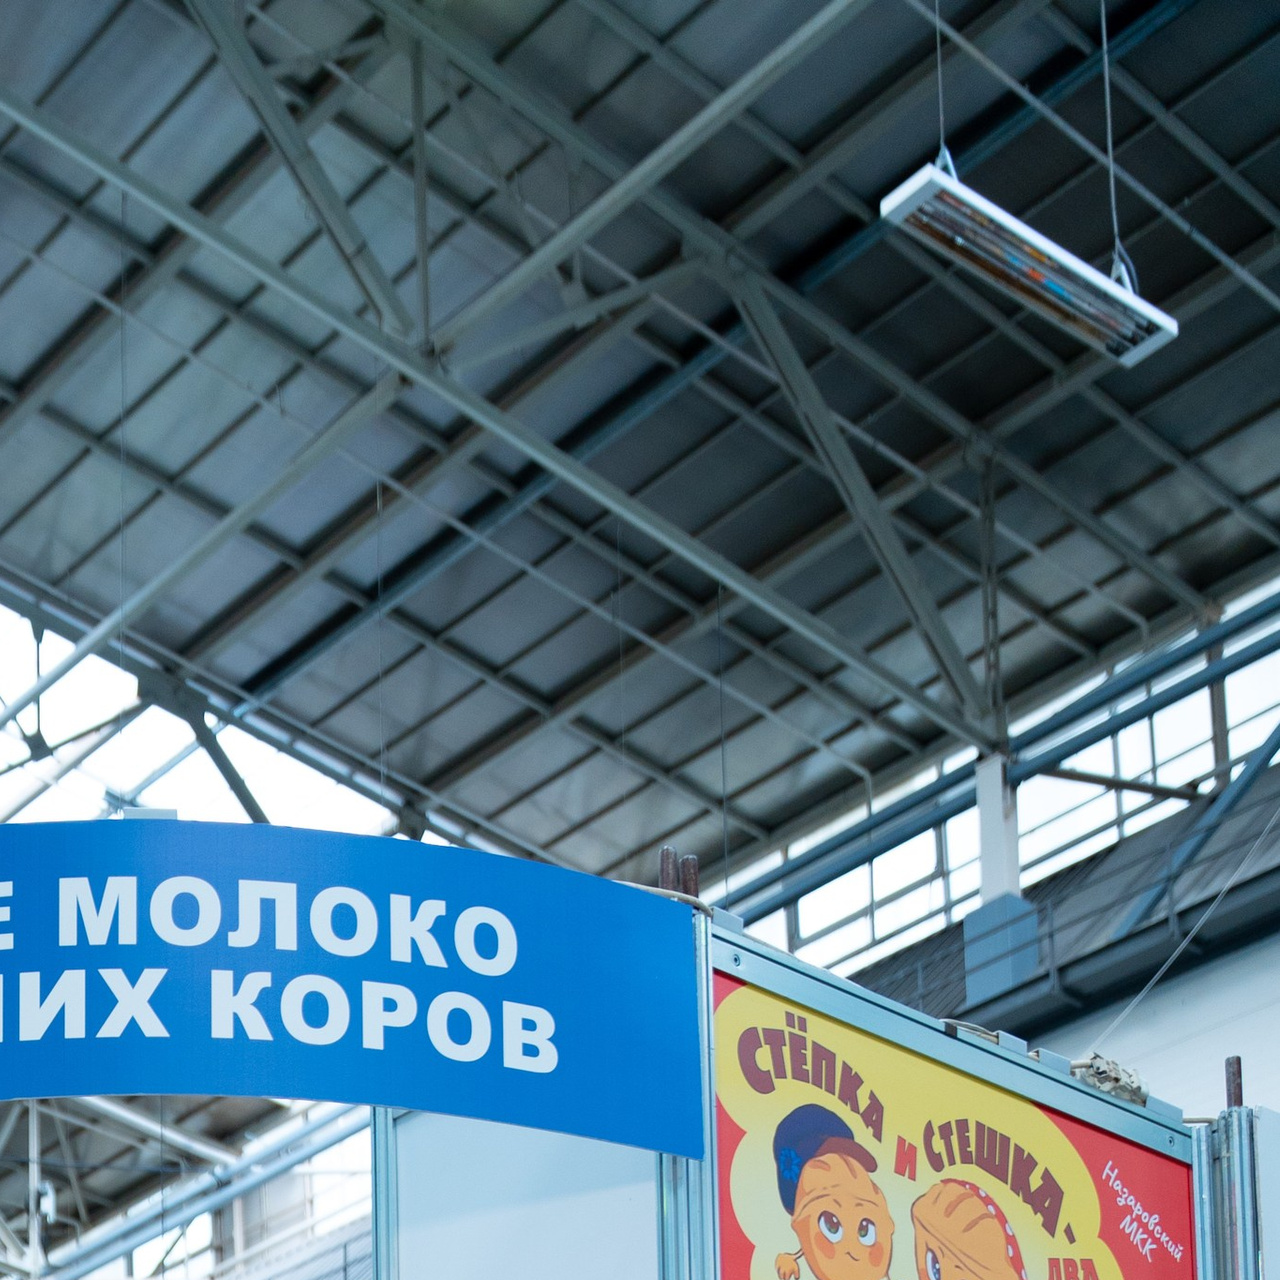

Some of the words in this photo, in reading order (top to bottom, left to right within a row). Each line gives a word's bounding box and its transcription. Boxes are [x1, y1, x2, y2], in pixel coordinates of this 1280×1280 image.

[57, 875, 519, 977] МОЛОКО
[212, 970, 560, 1074] КОРОВ
[737, 1011, 885, 1143] СТЁПКА
[1102, 1160, 1183, 1262] Назаровский
[1121, 1215, 1157, 1262] МКК
